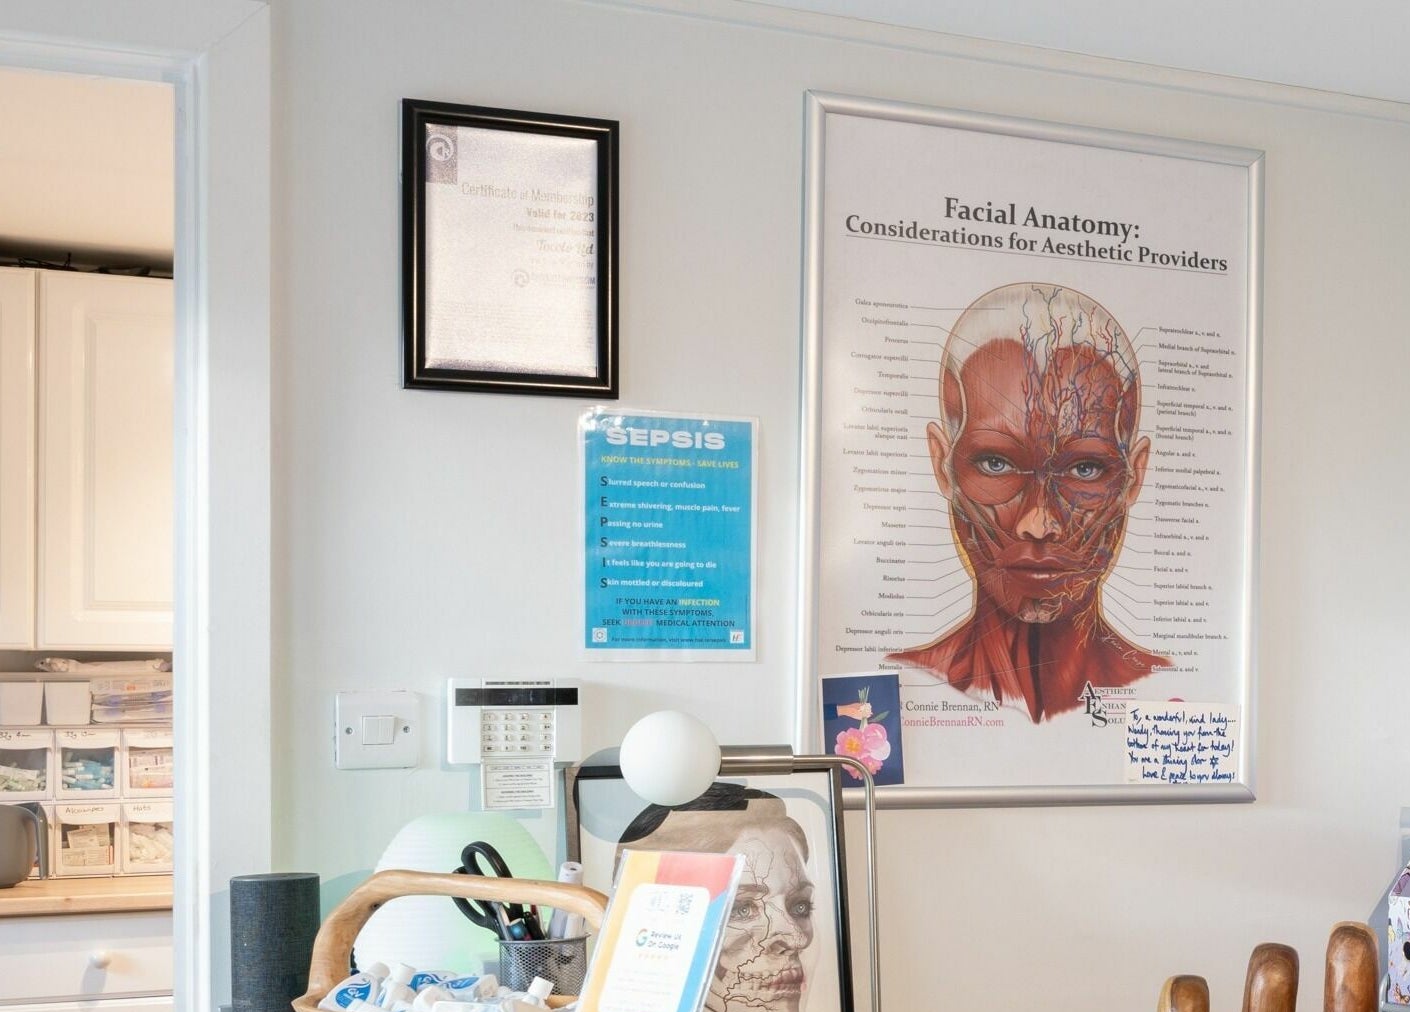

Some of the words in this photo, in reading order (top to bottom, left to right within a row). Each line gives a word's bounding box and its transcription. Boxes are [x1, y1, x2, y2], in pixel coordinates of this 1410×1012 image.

[945, 196, 1016, 226] Facial
[1024, 207, 1140, 243] Anatomy:
[845, 215, 1003, 248] Considerations
[1009, 232, 1037, 252] for
[1042, 237, 1133, 262] Aesthetic
[1138, 246, 1228, 272] Providers
[606, 427, 725, 450] SEPSIS
[601, 455, 627, 464] KNOW
[629, 457, 645, 465] THE
[645, 457, 691, 467] SYMPTOMS
[718, 461, 739, 469] LIVES
[632, 480, 659, 488] speech
[670, 480, 705, 489] confusion
[637, 502, 673, 511] shivering,
[675, 503, 701, 511] muscle
[702, 504, 720, 512] pain,
[721, 504, 740, 512] fever
[643, 520, 663, 528] urine
[631, 540, 686, 549] breathlessness
[611, 559, 630, 567] feels
[631, 559, 644, 567] like
[645, 561, 660, 569] you
[675, 561, 694, 569] going
[705, 561, 717, 569] die
[620, 579, 649, 587] mottled
[661, 580, 703, 588] discoloured
[679, 598, 720, 607] INFECTION
[1078, 681, 1137, 700] AESTHETIC
[906, 700, 938, 711] Connie
[942, 701, 982, 712] Brennan,
[984, 701, 1000, 711] RN
[1189, 713, 1205, 723] kind
[1183, 730, 1195, 745] you
[1213, 726, 1226, 737] the
[1151, 739, 1159, 751] of
[1161, 743, 1171, 757] my
[1197, 742, 1209, 754] for
[1142, 765, 1159, 779] Love
[1161, 767, 1167, 780] &
